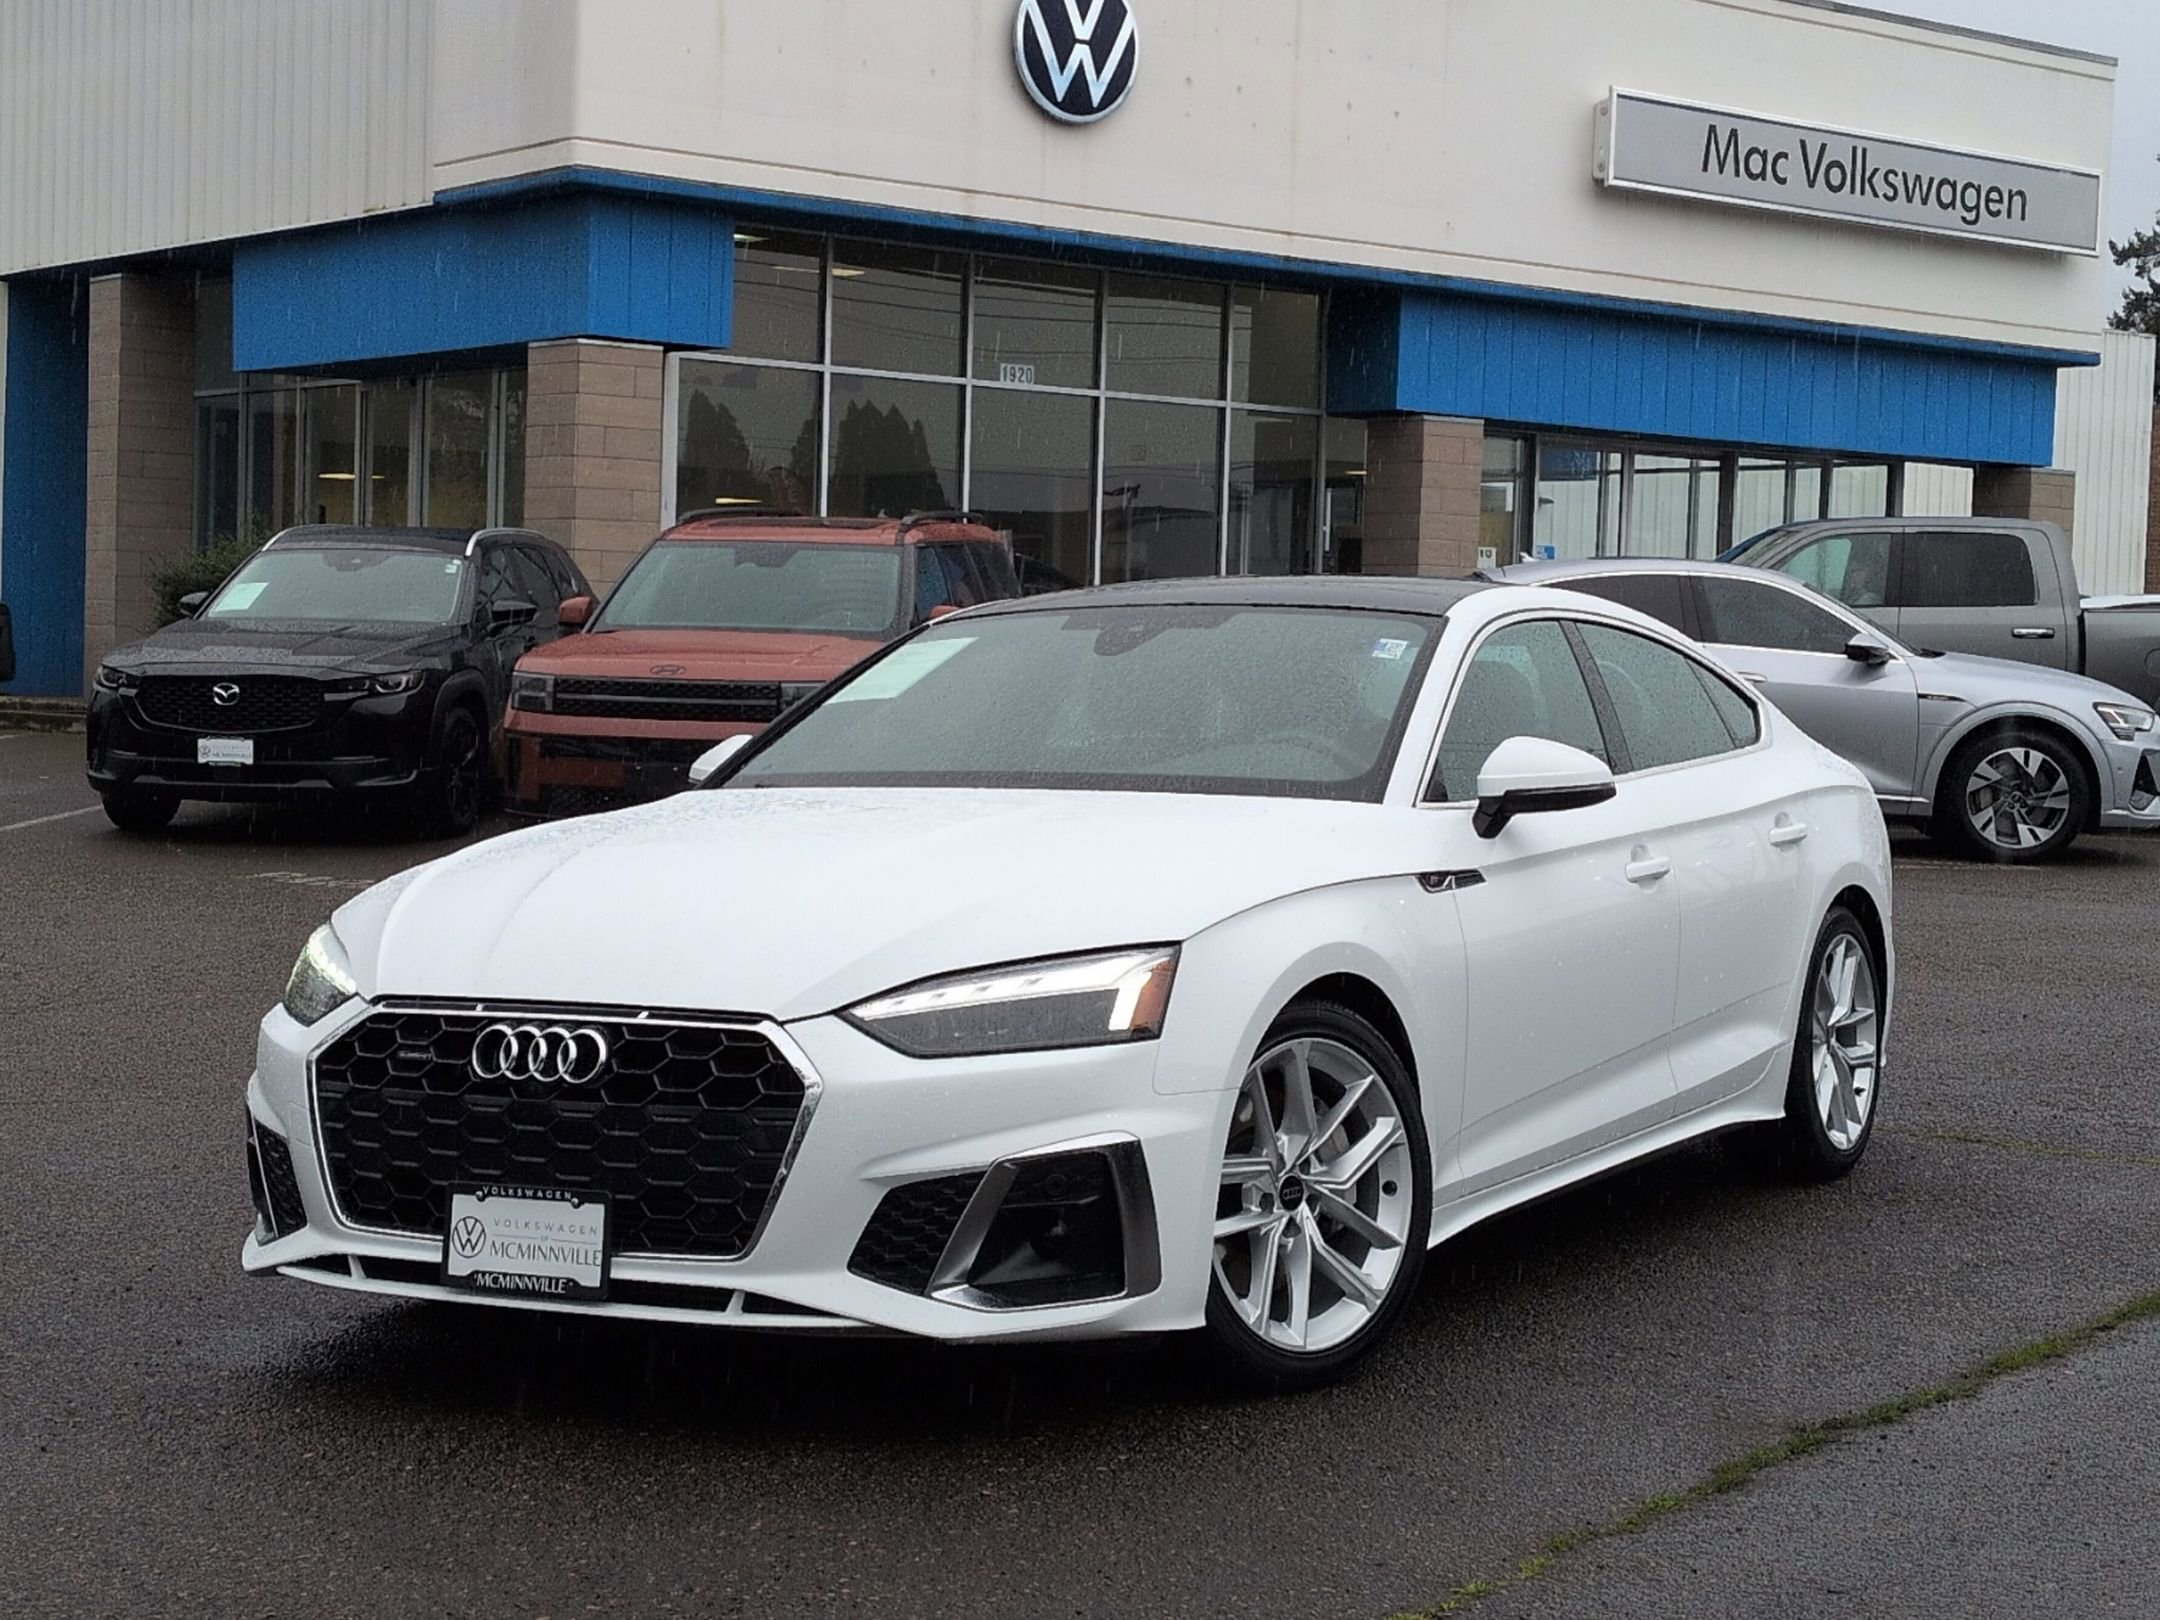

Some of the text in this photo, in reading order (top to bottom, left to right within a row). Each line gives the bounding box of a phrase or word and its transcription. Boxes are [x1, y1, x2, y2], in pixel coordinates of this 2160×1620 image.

[1702, 124, 2027, 226] Mac Volkswagen
[1002, 365, 1033, 384] 1920
[482, 1185, 572, 1200] VOLKSWAGEN
[494, 1218, 598, 1236] VOLKSWAGEN
[490, 1240, 600, 1267] MCMINNVILLE
[475, 1273, 567, 1294] MCMINNVILLE
